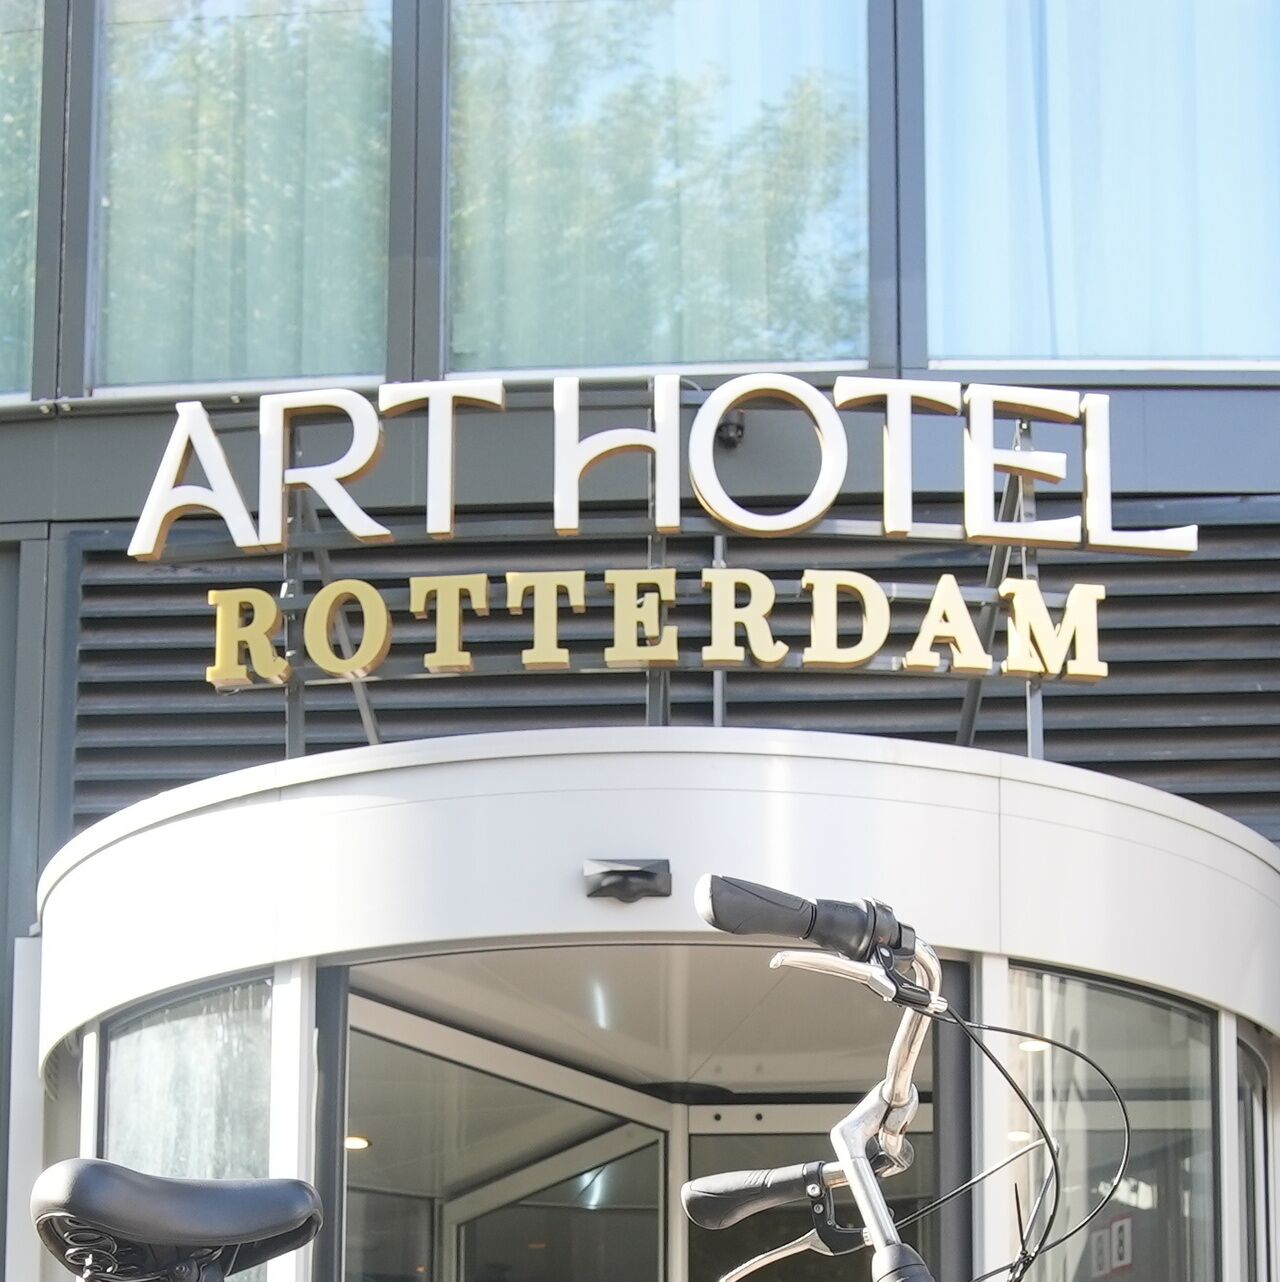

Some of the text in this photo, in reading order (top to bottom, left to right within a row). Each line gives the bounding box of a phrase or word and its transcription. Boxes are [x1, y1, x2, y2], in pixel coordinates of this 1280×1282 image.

[127, 373, 1198, 561] ART HOTEL
[205, 567, 1109, 690] ROTTERDAM
